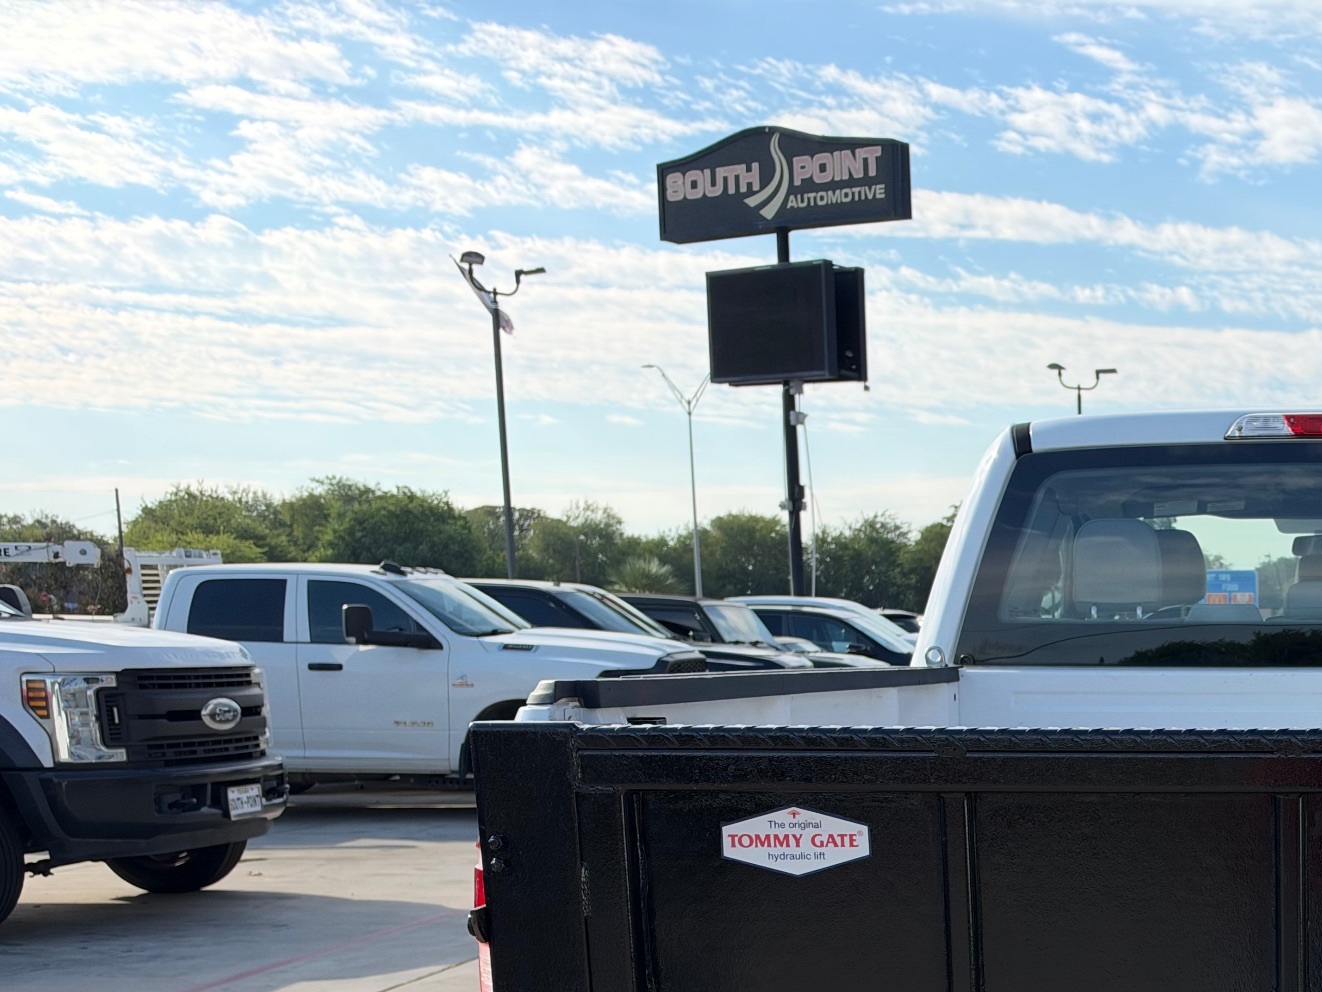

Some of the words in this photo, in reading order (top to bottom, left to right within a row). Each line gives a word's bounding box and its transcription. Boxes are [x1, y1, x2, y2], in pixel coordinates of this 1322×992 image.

[665, 161, 760, 202] SOUTH
[792, 145, 882, 187] POINT
[786, 184, 886, 209] AUTOMOTIVE
[767, 820, 786, 829] The
[788, 819, 822, 831] original
[727, 833, 803, 848] TOMMY
[767, 851, 812, 863] hydraulic
[813, 851, 826, 861] lift
